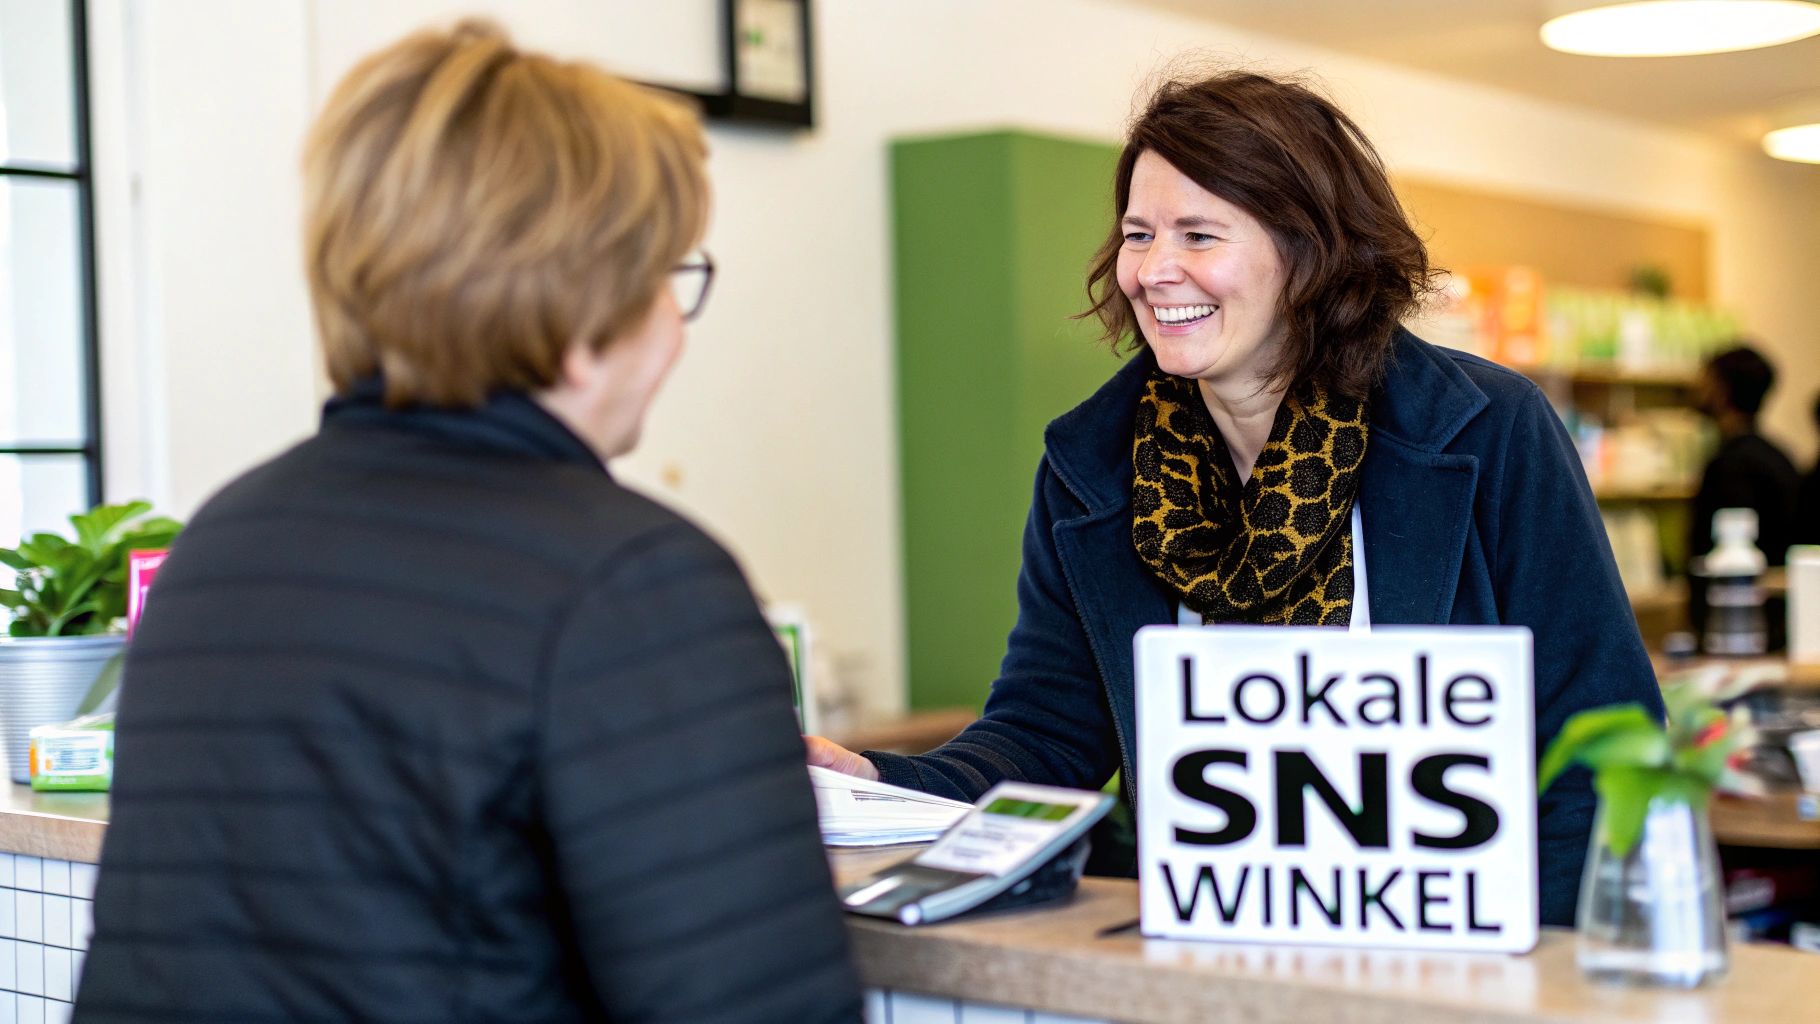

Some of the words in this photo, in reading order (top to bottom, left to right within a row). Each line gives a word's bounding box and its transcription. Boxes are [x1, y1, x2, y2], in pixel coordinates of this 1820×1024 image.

[1180, 653, 1495, 728] Lokale
[1170, 747, 1501, 852] SNS
[1159, 861, 1502, 934] WINKEL
